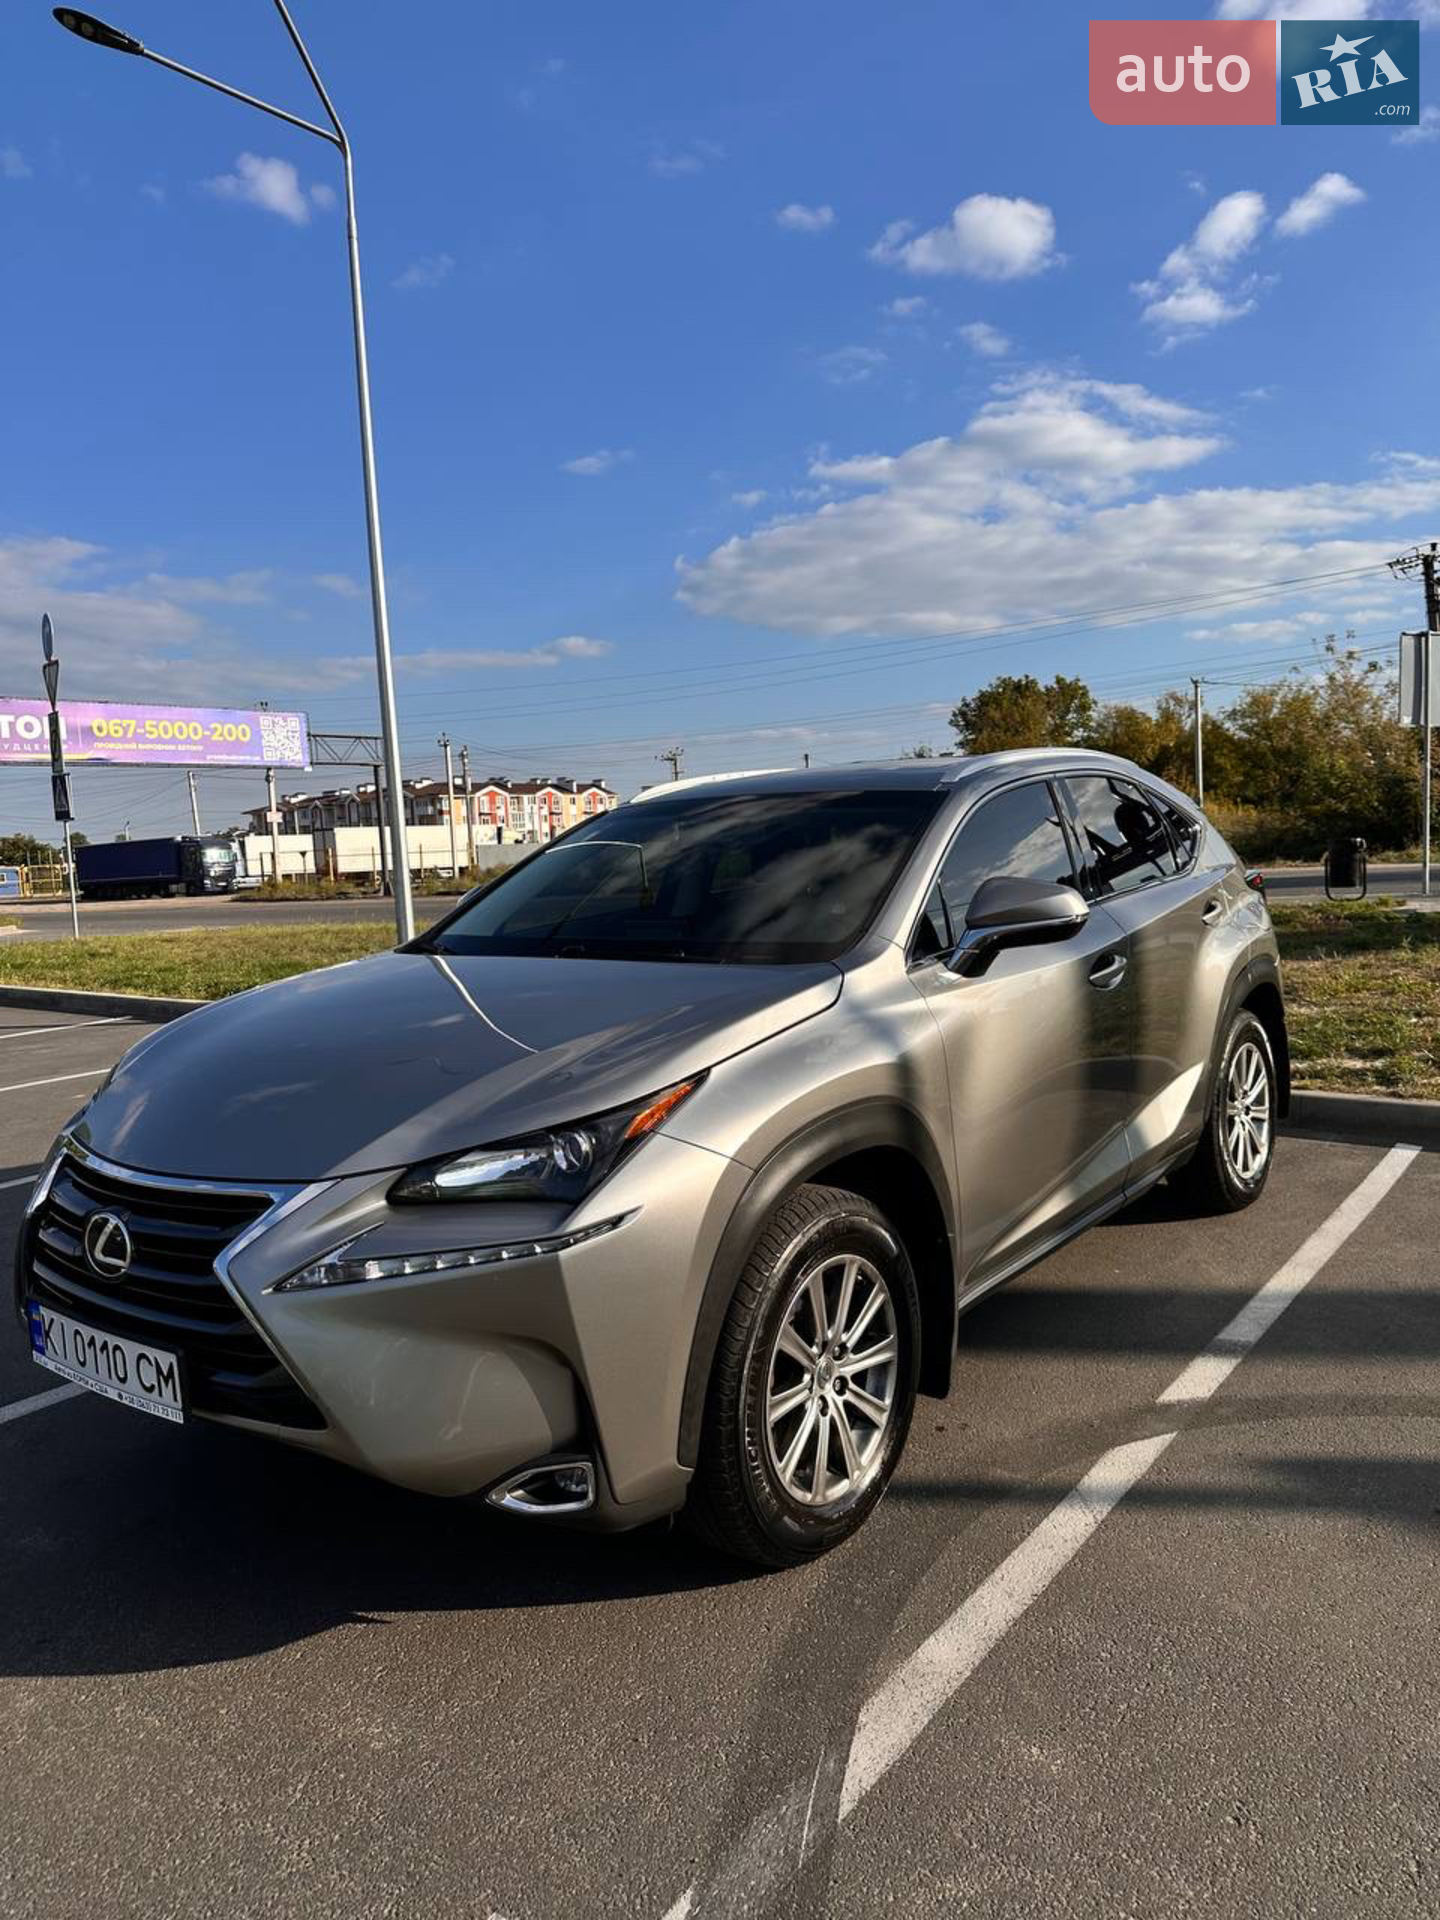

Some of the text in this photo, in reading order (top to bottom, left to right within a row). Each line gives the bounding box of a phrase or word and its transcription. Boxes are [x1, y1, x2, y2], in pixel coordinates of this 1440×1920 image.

[91, 718, 251, 742] 067-5000-200
[73, 1328, 128, 1384] 0110
[136, 1352, 178, 1403] CM
